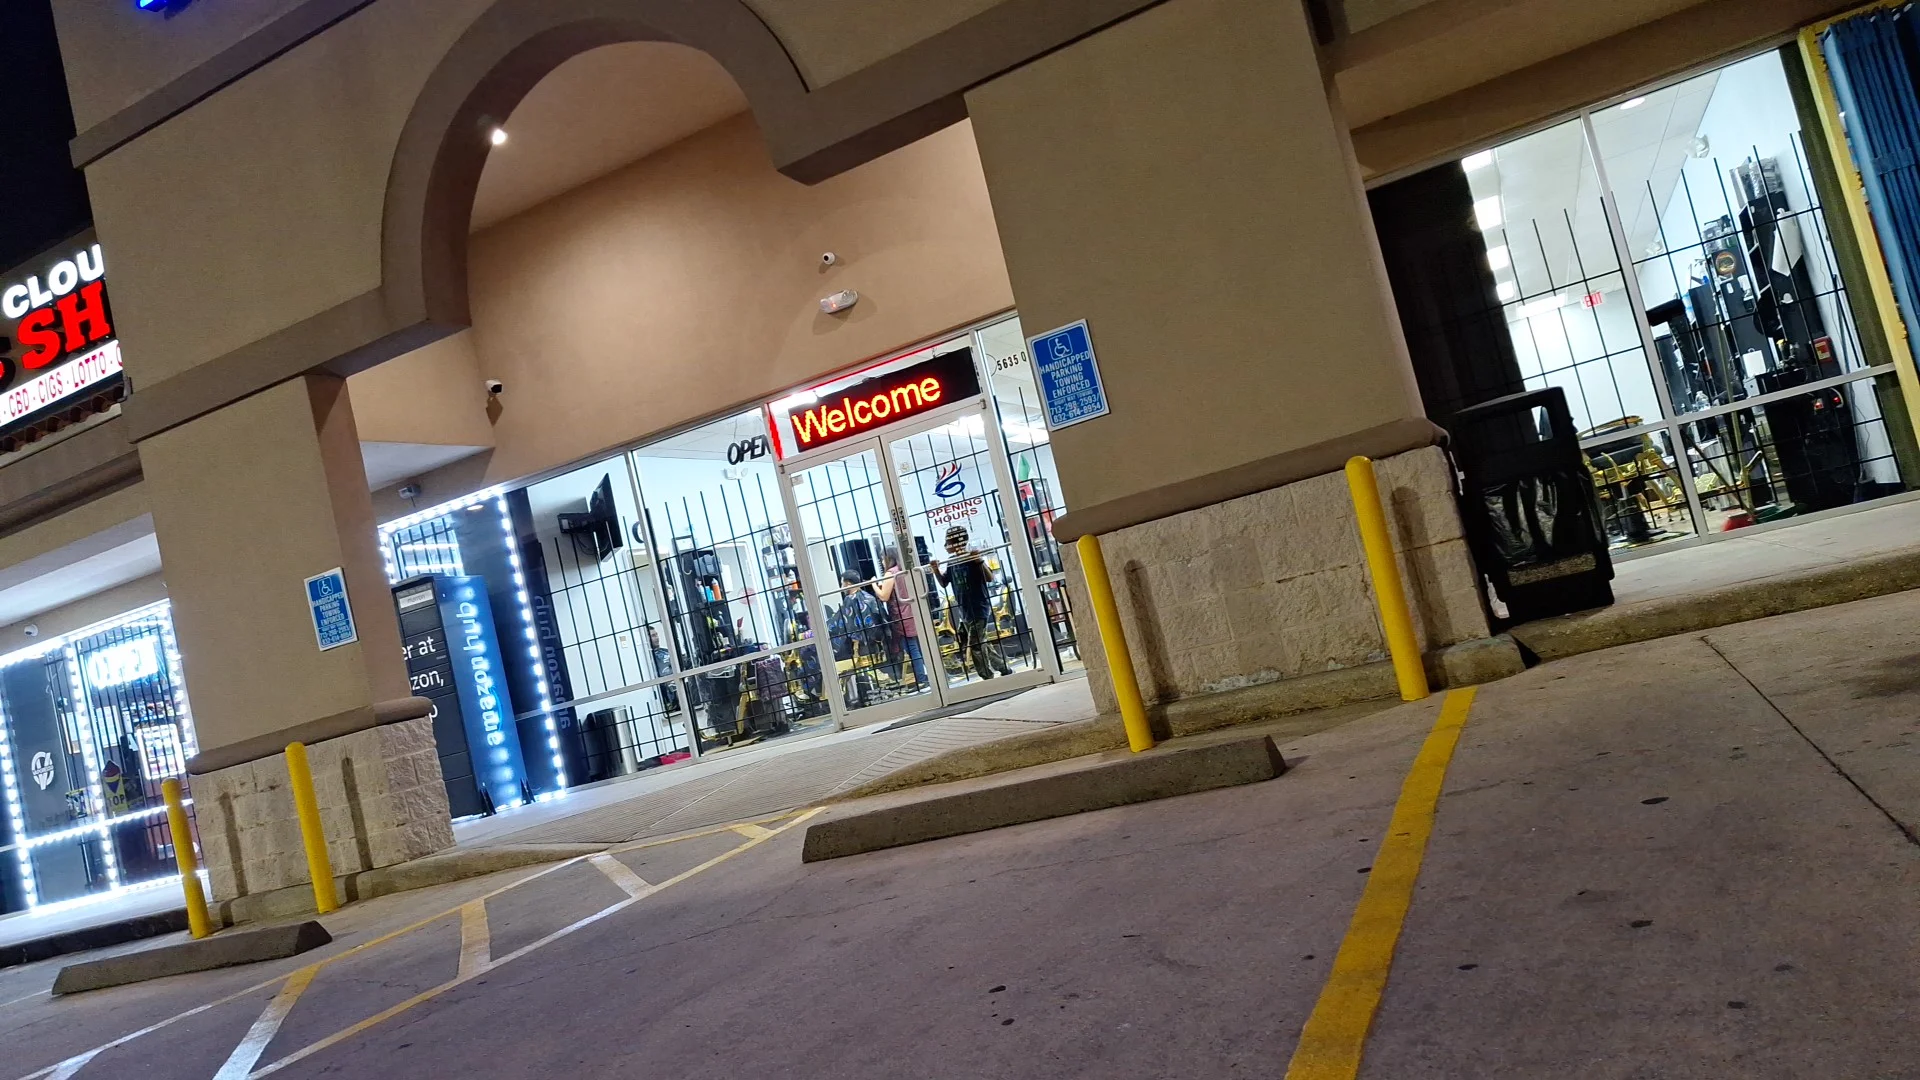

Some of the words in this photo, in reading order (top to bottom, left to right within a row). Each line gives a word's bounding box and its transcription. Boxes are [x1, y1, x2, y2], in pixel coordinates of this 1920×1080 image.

[17, 280, 111, 370] SH
[997, 354, 1019, 371] 5635
[1040, 351, 1090, 374] HANDICAPPED
[1051, 362, 1083, 380] PARKING
[9, 388, 29, 417] CBD
[38, 372, 63, 403] CIGS
[71, 351, 106, 388] LOTTO
[1052, 379, 1090, 398] ENFORCED
[1054, 372, 1083, 388] TOWING
[792, 377, 941, 443] Welcome
[926, 498, 982, 519] OPENING
[934, 508, 978, 525] HOURS
[456, 602, 484, 651] hub
[418, 636, 436, 656] at
[471, 656, 504, 746] amazon
